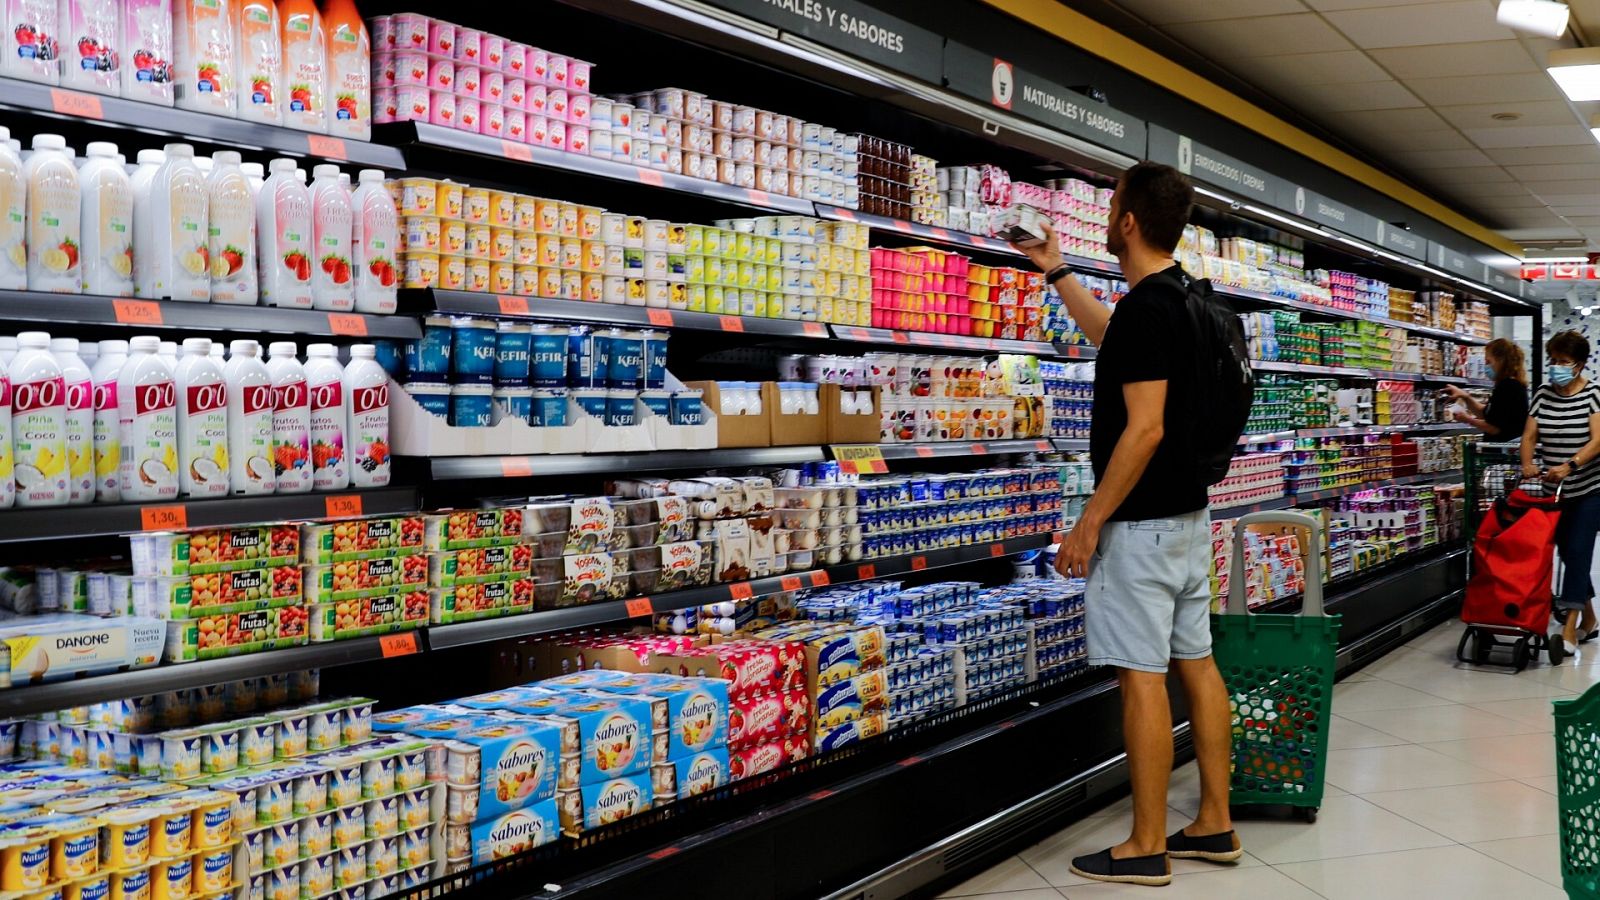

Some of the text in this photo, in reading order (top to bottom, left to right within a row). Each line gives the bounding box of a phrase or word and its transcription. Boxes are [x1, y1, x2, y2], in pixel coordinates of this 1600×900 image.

[826, 7, 837, 27] Y
[839, 13, 904, 53] SABORES
[1023, 85, 1126, 138] NATURALES Y SABORES
[1195, 153, 1239, 182] ENRIQUECIDOS
[1243, 173, 1265, 191] CREMAS
[25, 432, 56, 440] Coco
[476, 517, 496, 528] frutas
[368, 527, 391, 538] frutas
[231, 535, 260, 547] frutas
[485, 553, 504, 563] frutas
[369, 564, 393, 576] frutas
[233, 576, 260, 588] frutas
[485, 587, 504, 598] frutas
[371, 601, 394, 614] frutas
[240, 617, 267, 630] frutas
[133, 628, 160, 636] Nueva
[134, 635, 160, 643] receta
[828, 642, 855, 664] natural
[746, 656, 765, 673] fresa
[742, 661, 773, 686] morango
[828, 686, 856, 709] natural
[682, 701, 717, 719] sabores
[753, 702, 770, 719] fresa
[748, 707, 779, 731] morango
[595, 722, 638, 742] sabores
[497, 749, 545, 771] sabores
[753, 748, 771, 765] fresa
[688, 762, 720, 782] sabores
[598, 787, 639, 809] sabores
[166, 819, 191, 831] Natura
[490, 820, 542, 843] sabores
[123, 831, 149, 842] Natura
[64, 841, 96, 854] Natural
[21, 851, 49, 863] Natura
[204, 857, 231, 869] Natural
[123, 877, 149, 889] Natura
